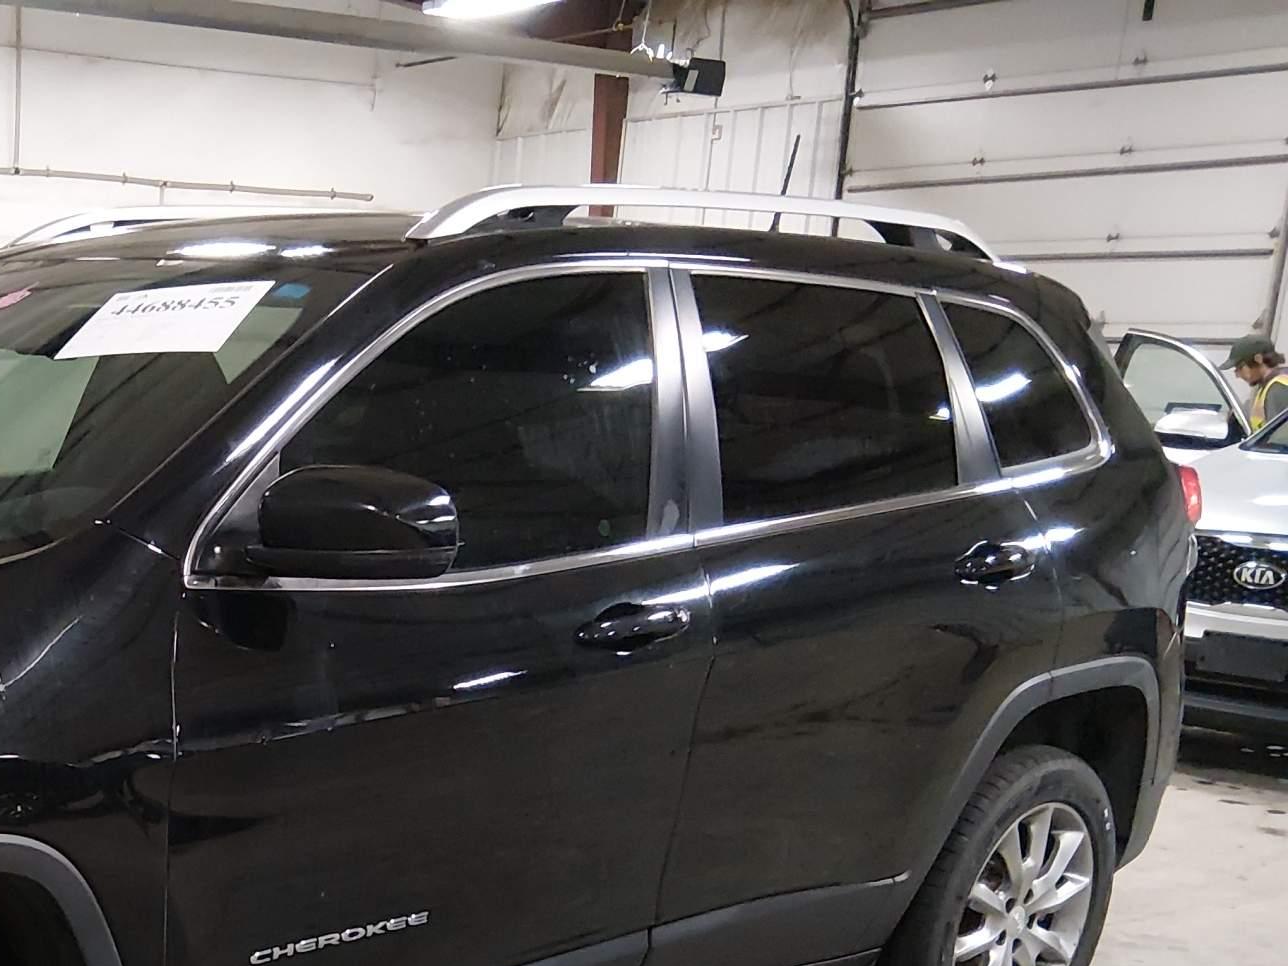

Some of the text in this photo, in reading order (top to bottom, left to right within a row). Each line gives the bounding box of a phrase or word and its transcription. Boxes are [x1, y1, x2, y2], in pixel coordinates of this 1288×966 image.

[110, 296, 241, 316] 44688455
[1240, 567, 1275, 585] KIA
[249, 911, 430, 965] CHEROKEE
